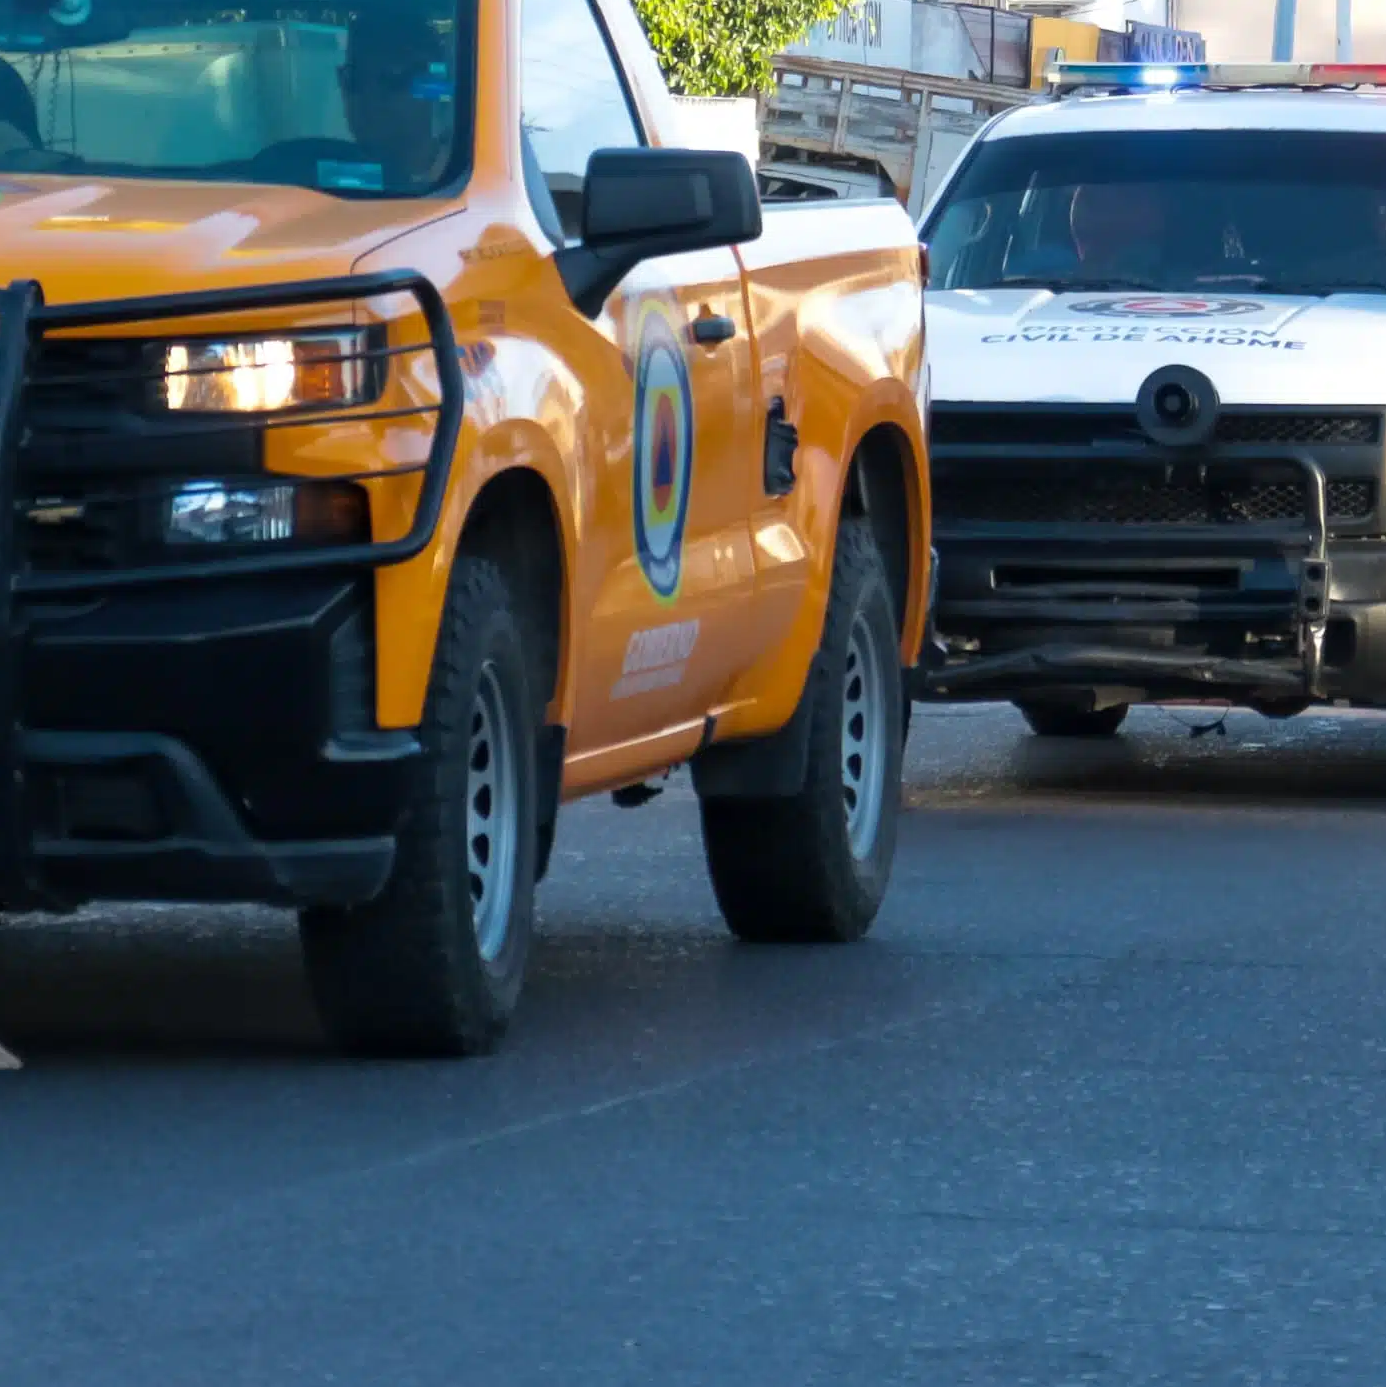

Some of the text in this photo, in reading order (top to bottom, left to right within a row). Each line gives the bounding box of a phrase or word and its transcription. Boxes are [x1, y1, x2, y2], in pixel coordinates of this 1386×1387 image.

[980, 333, 1307, 351] CIVIL DE AHOME
